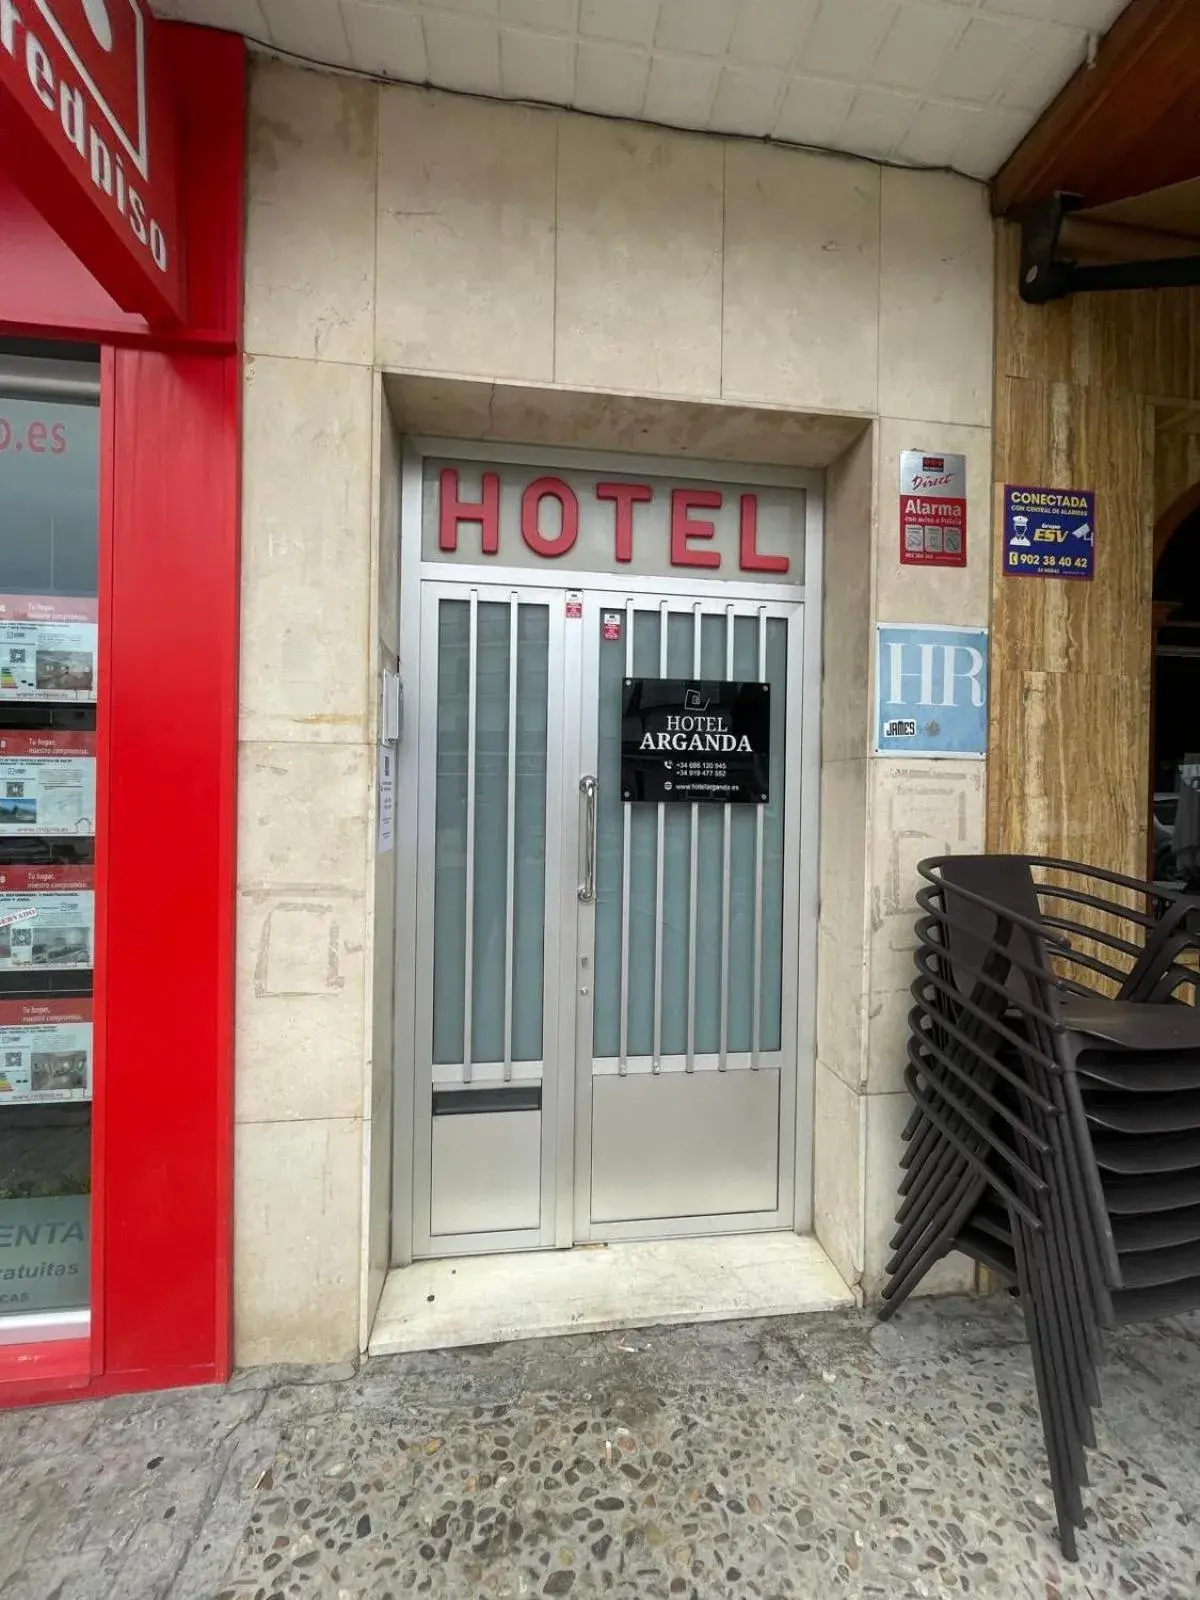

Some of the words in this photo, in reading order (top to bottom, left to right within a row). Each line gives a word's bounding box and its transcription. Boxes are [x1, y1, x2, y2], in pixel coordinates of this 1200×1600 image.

[904, 498, 962, 517] Alarma
[1010, 492, 1088, 508] CONECTADA
[1026, 506, 1051, 514] CENTRAL
[438, 468, 790, 573] HOTEL
[1033, 528, 1069, 543] ESV
[1020, 553, 1040, 565] 902
[1043, 555, 1056, 566] 38
[1058, 556, 1072, 567] 40
[1074, 557, 1088, 568] 42
[884, 642, 986, 708] HR
[666, 715, 728, 732] HOTEL
[886, 720, 915, 736] JAMES
[639, 732, 753, 752] ARGANDA
[676, 761, 688, 769] +34
[676, 769, 688, 777] +34
